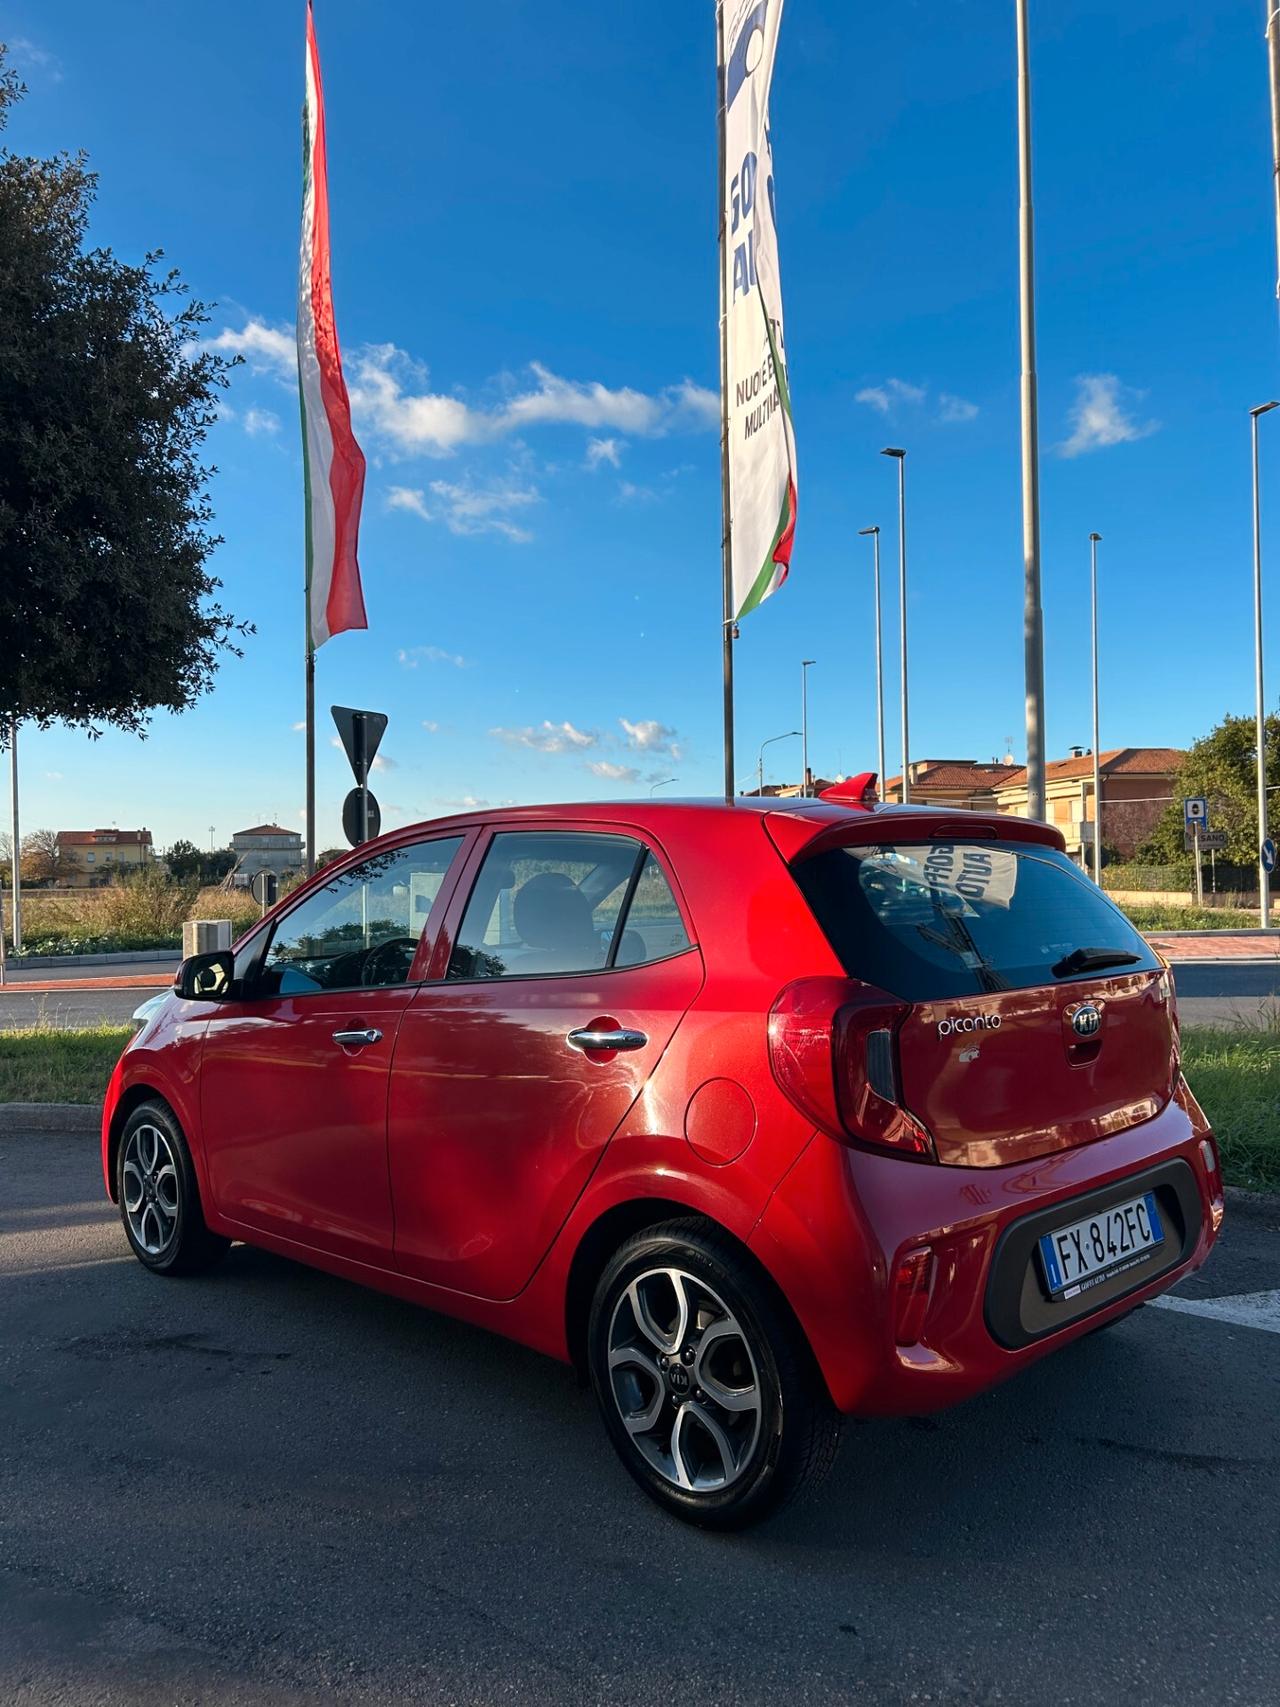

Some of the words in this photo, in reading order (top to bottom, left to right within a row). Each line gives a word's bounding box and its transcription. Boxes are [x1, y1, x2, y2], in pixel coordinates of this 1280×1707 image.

[937, 1012, 1001, 1041] picanto
[1056, 1228, 1089, 1280] FX
[1090, 1202, 1151, 1263] 842FC
[670, 1372, 689, 1386] KIA
